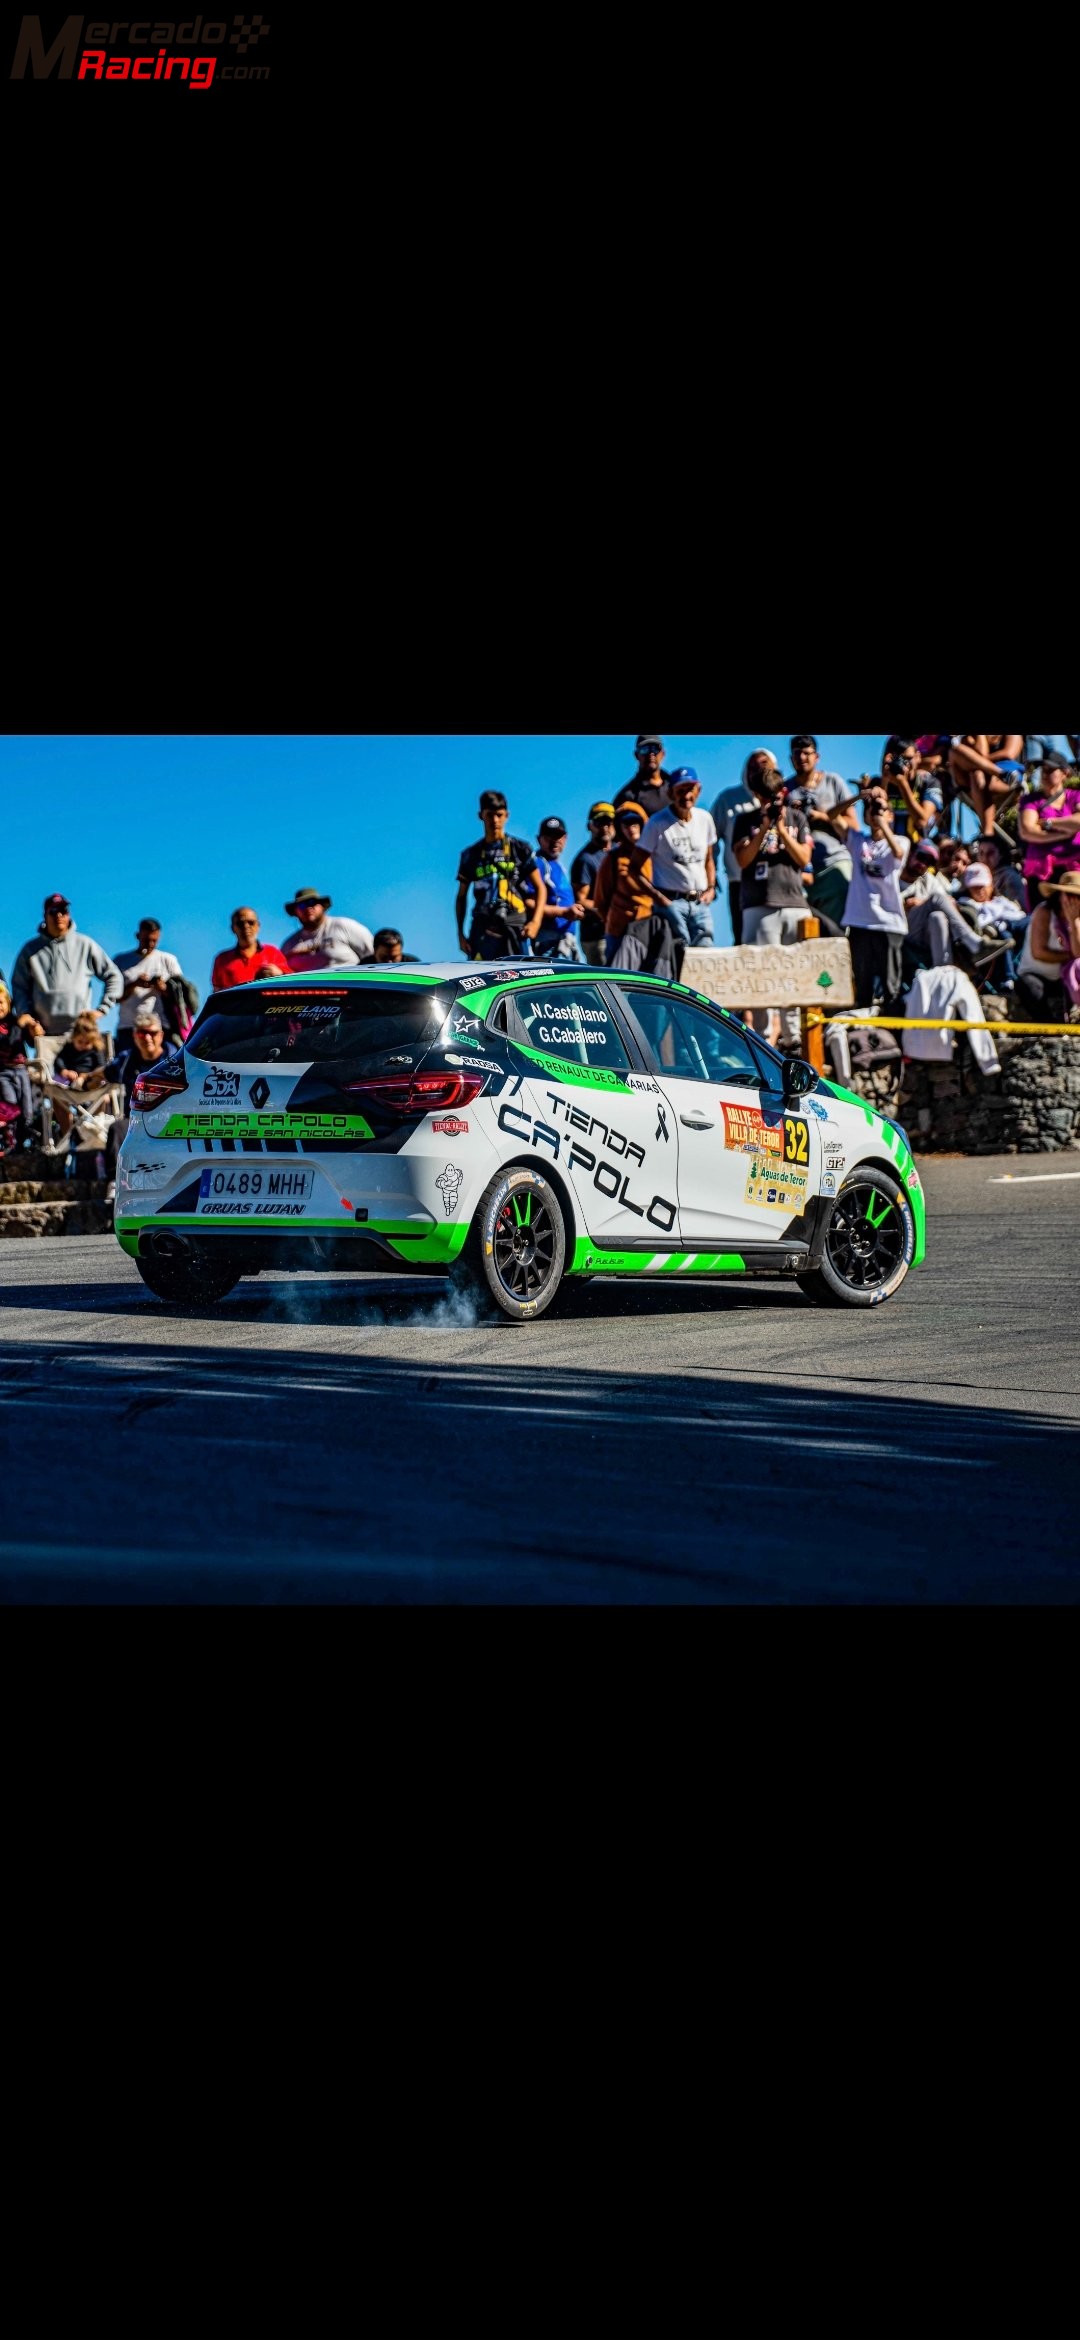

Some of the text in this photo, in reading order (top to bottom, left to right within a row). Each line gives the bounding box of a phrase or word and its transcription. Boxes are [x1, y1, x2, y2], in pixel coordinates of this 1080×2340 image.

[733, 956, 756, 973] DE
[761, 954, 795, 971] LOS
[701, 980, 726, 995] DE
[264, 1005, 341, 1014] DRIVELAND
[530, 1002, 608, 1023] N.Castellano
[539, 1026, 607, 1045] G.Caballero
[545, 1060, 592, 1080] RENAULT
[592, 1071, 606, 1082] DE
[607, 1073, 660, 1094] CANARIAS
[726, 1107, 752, 1126] RALLYE
[165, 1128, 184, 1137] LA
[187, 1129, 234, 1137] ALDEA
[238, 1129, 259, 1137] DE
[729, 1122, 780, 1149] VILLA DE TEROR
[785, 1119, 808, 1162] 32
[213, 1173, 306, 1196] 0489 MHH
[760, 1166, 806, 1187] Aguas de Teror
[200, 1203, 306, 1215] GRUAS LUJAN
